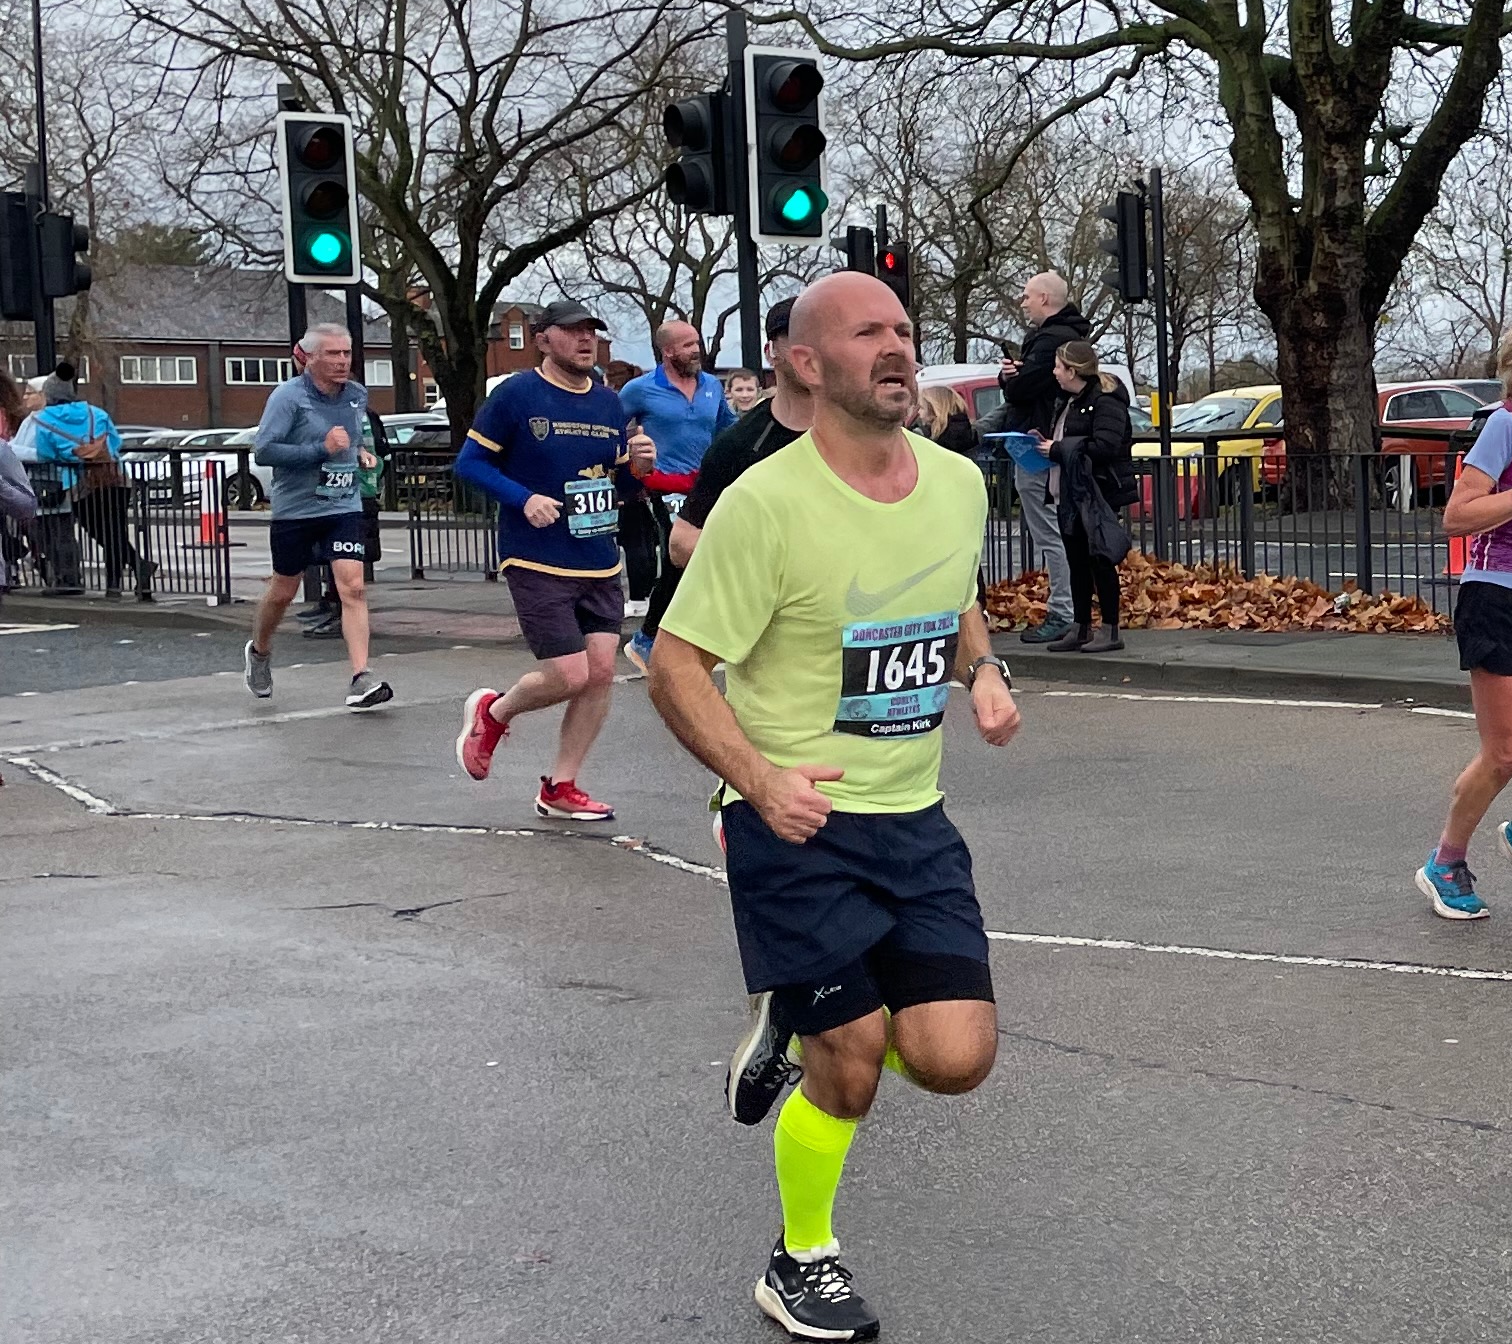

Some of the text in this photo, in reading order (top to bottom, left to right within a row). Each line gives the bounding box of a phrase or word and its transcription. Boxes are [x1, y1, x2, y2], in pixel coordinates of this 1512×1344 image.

[574, 489, 613, 514] 3161
[852, 625, 903, 642] DONCASTER
[866, 639, 946, 693] 1645
[870, 718, 931, 735] Captain Kirk
